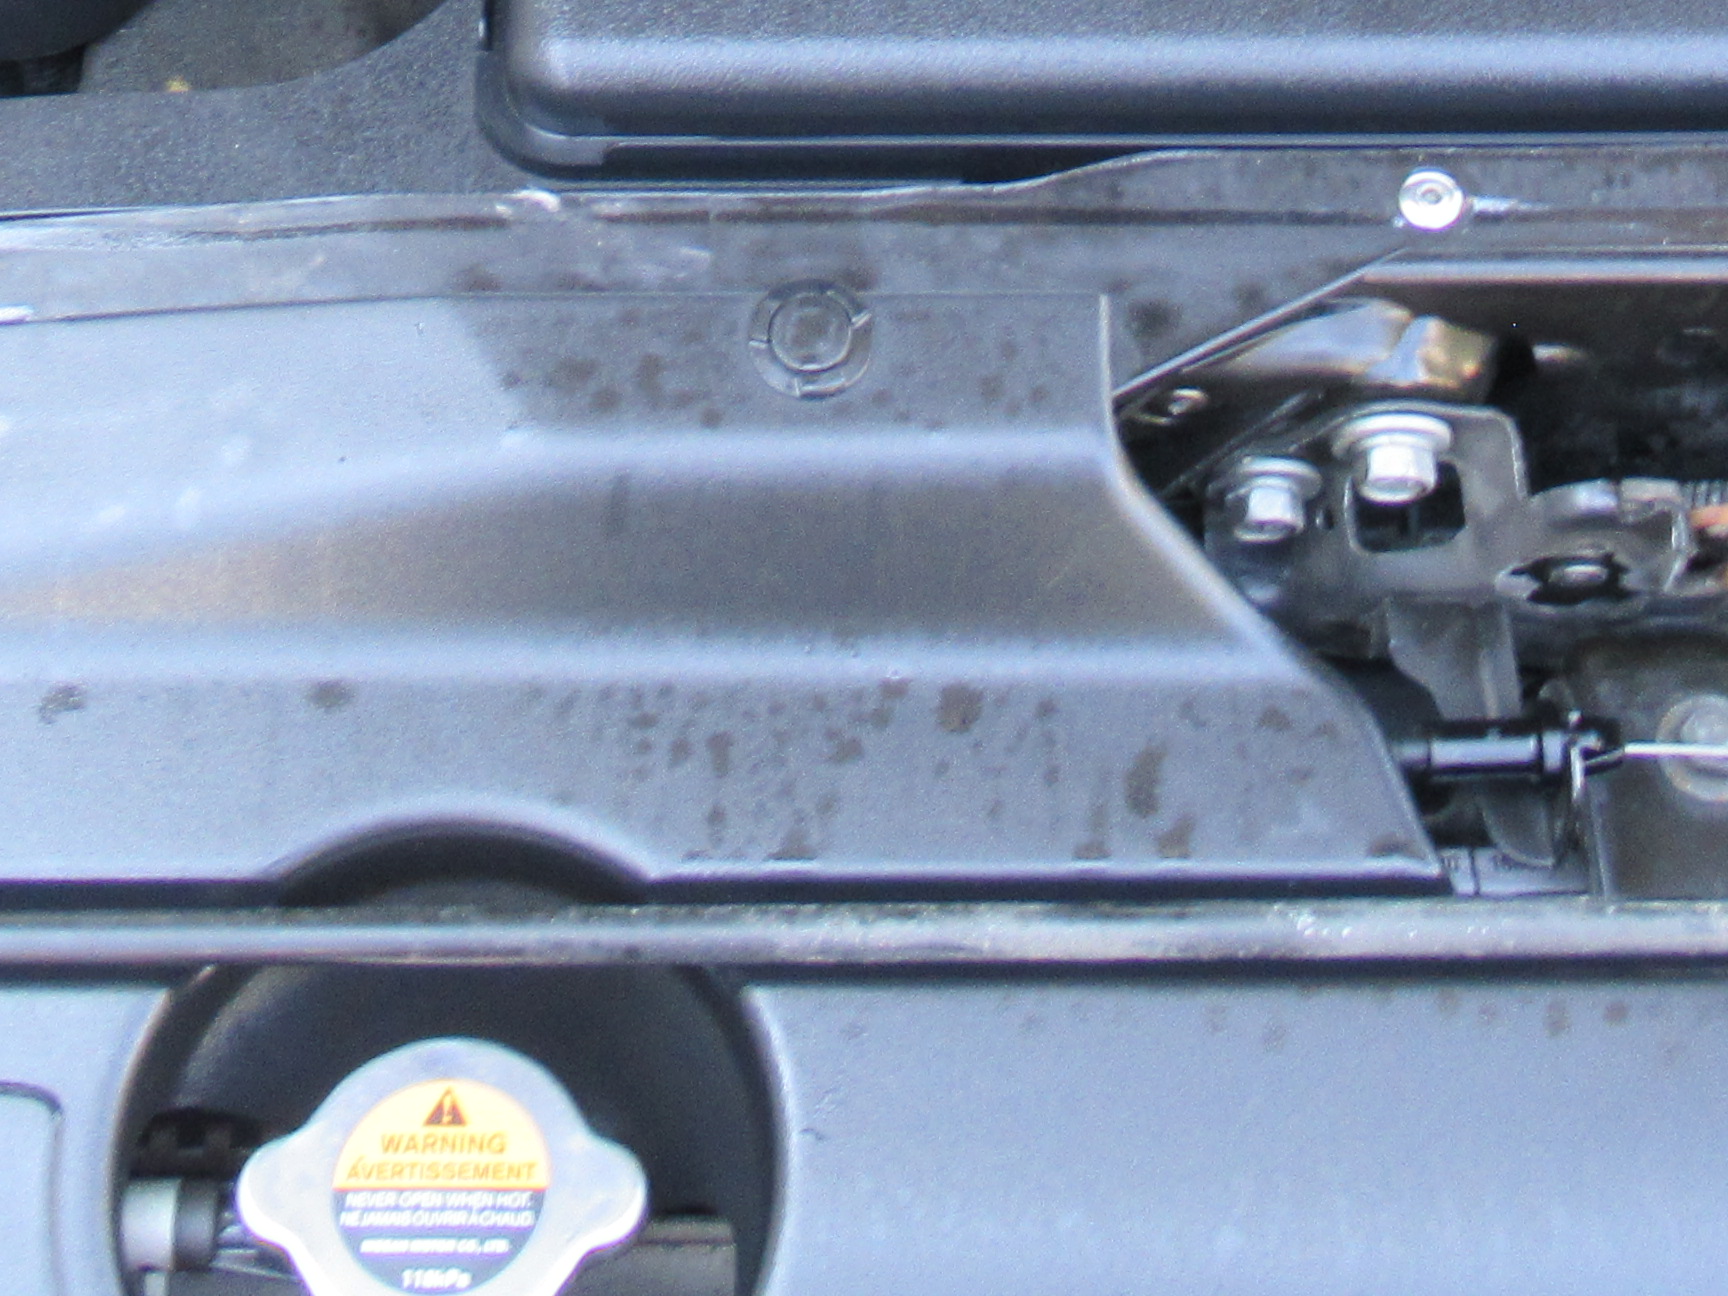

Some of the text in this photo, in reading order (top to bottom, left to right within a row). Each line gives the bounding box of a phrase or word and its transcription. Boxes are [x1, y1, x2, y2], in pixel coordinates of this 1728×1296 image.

[381, 1132, 508, 1155] WARNING
[345, 1191, 396, 1208] NEVER
[398, 1191, 442, 1208] OPEN
[446, 1191, 494, 1208] WHEN
